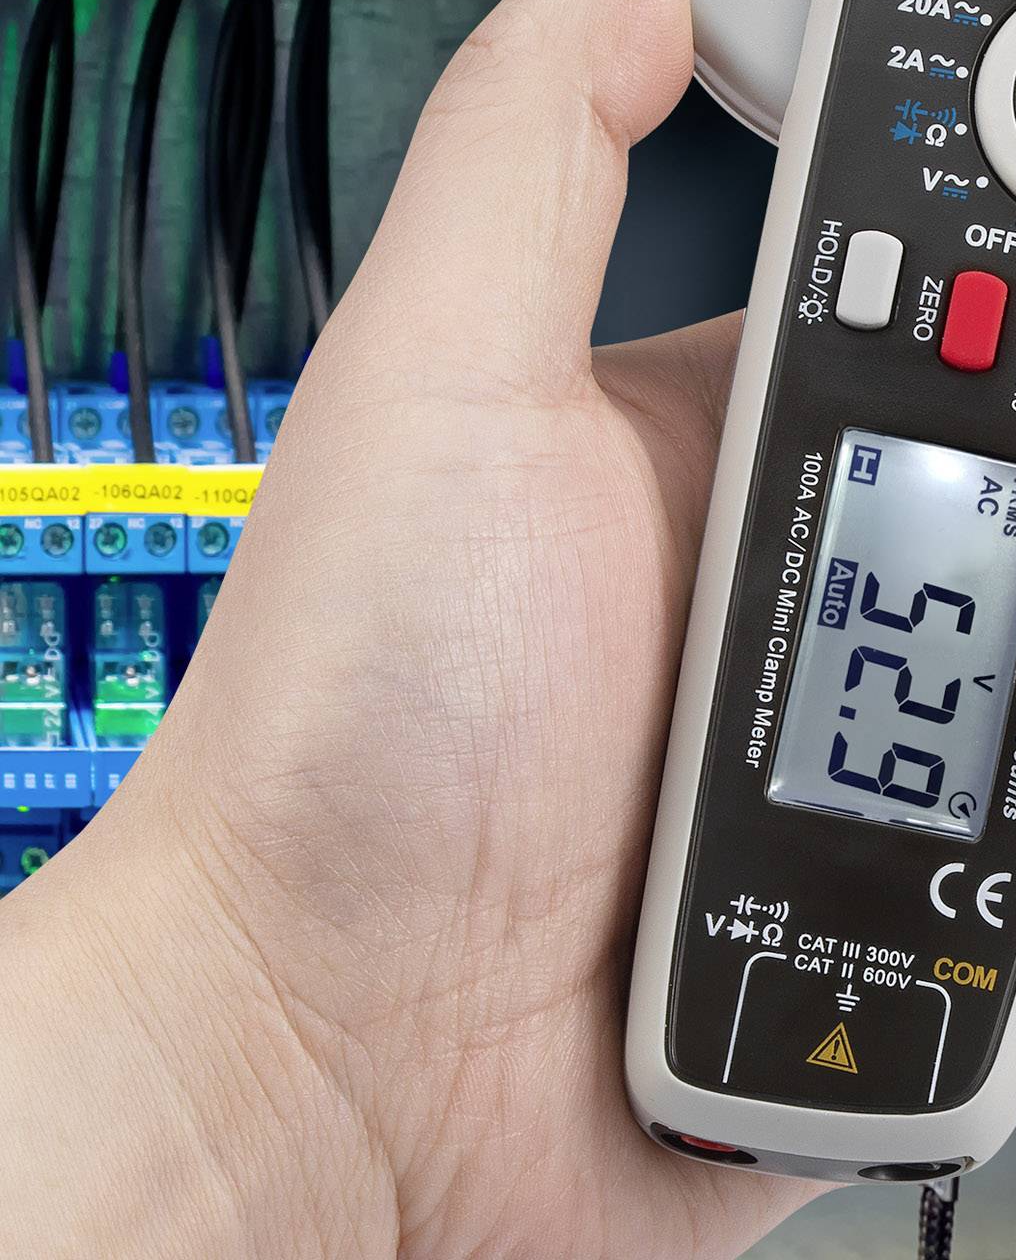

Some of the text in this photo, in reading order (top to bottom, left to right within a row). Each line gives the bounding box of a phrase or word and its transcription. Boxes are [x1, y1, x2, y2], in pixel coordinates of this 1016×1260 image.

[887, 44, 925, 73] 2A
[913, 275, 944, 342] ZERO
[94, 485, 183, 500] -106QA02
[977, 475, 1003, 517] AC
[745, 451, 824, 769] 100A AC/DC Mini Clamp Meter
[820, 559, 856, 626] Auto
[972, 674, 996, 693] V
[798, 934, 916, 970] CAT III 300V
[793, 953, 913, 990] CAT II 600V
[932, 956, 999, 992] COM
